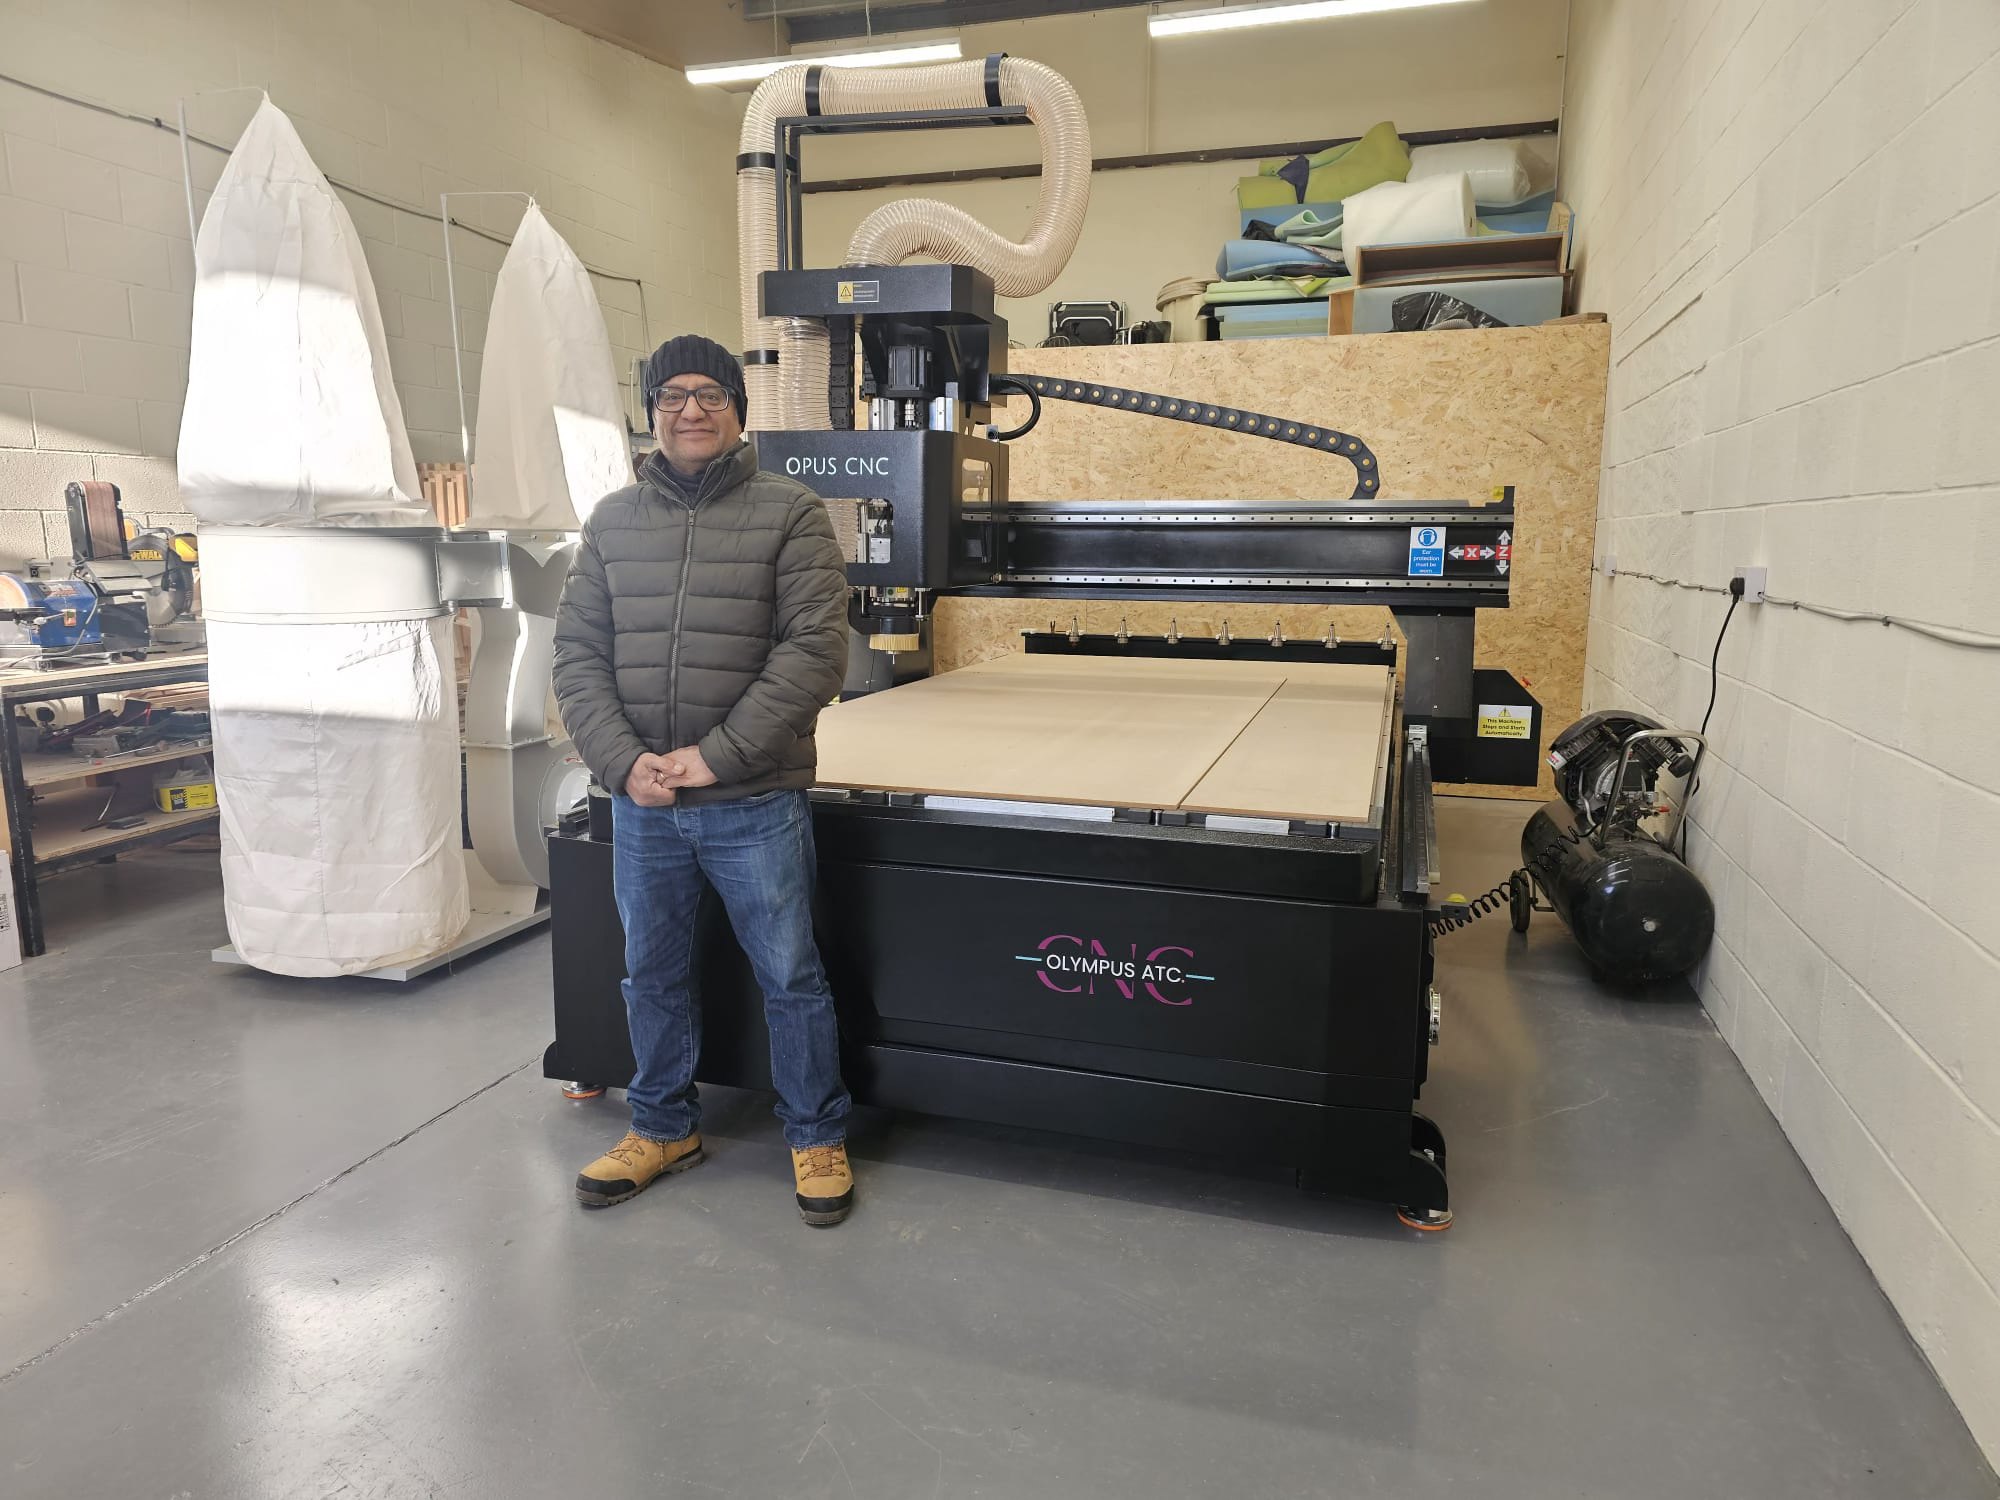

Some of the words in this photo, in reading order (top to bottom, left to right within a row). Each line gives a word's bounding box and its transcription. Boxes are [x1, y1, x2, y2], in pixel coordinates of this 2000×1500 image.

[785, 457, 837, 475] OPUS
[845, 457, 889, 475] CNC
[1466, 547, 1479, 558] X
[1046, 954, 1135, 978] OLYMPUS
[1141, 964, 1185, 984] ATC.
